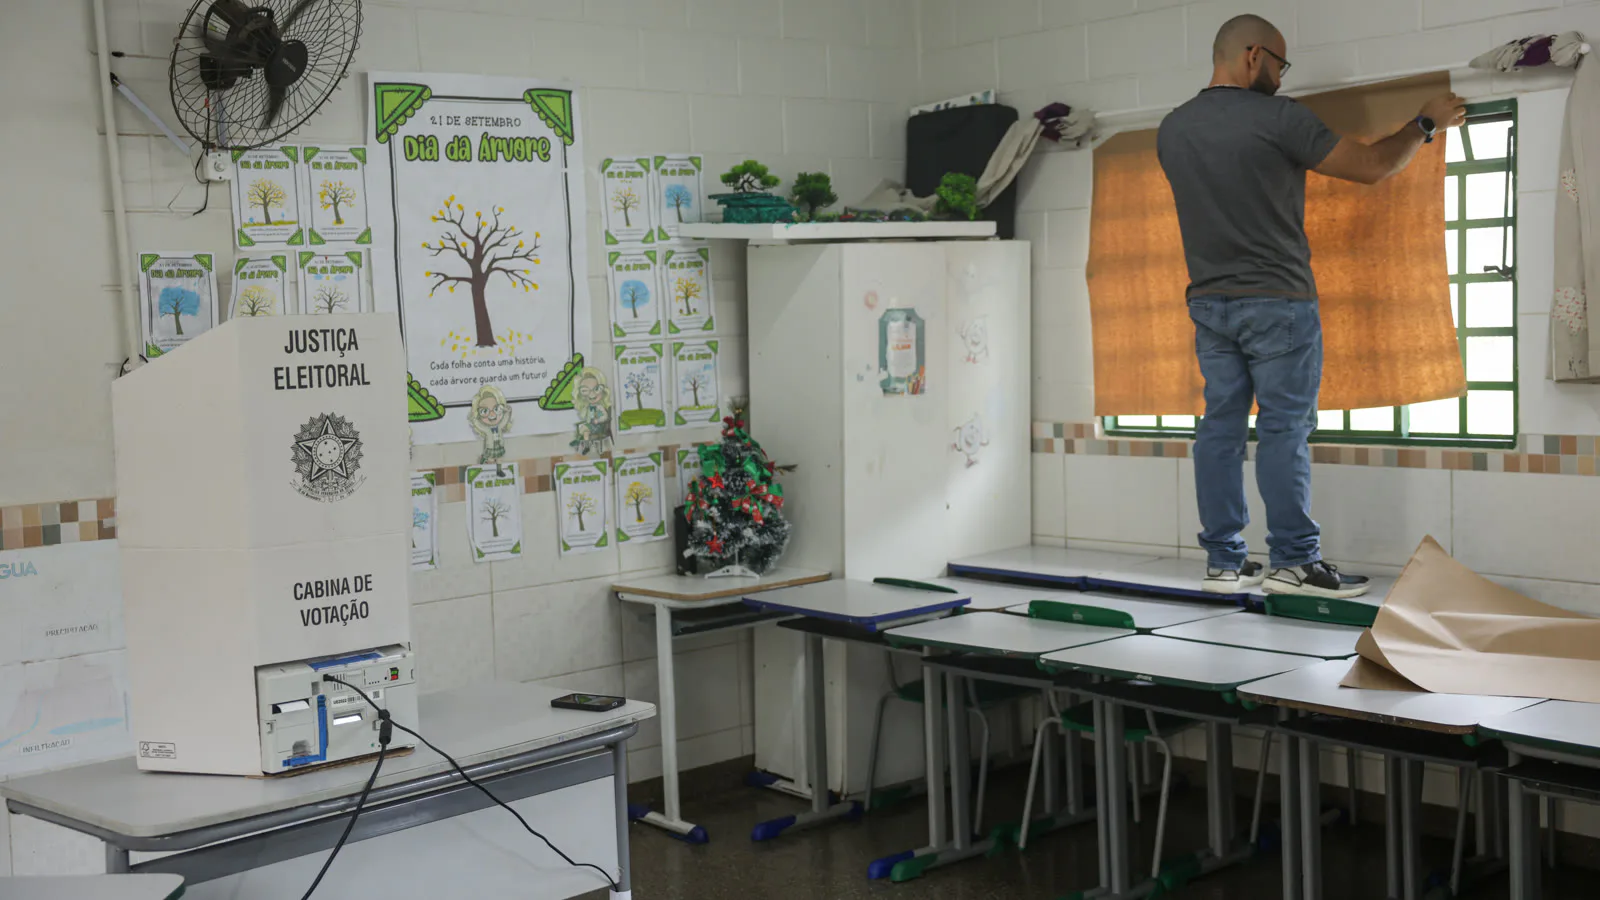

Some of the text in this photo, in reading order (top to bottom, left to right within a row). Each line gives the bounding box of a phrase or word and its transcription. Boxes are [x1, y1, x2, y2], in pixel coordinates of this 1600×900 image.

[446, 115, 461, 126] DE
[464, 116, 522, 128] SETEMBRO
[403, 131, 551, 162] Dia da Árvore
[284, 327, 359, 358] JUSTIÇA
[273, 363, 371, 391] ELEITORAL
[430, 360, 450, 371] Cada
[451, 358, 472, 370] folha
[473, 358, 496, 369] conta
[497, 358, 514, 367] uma
[430, 377, 449, 387] cada
[450, 374, 478, 385] árvore
[479, 373, 508, 386] guarda
[509, 373, 520, 381] um
[293, 574, 373, 601] CABINA DE
[300, 599, 370, 627] VOTAÇÃO
